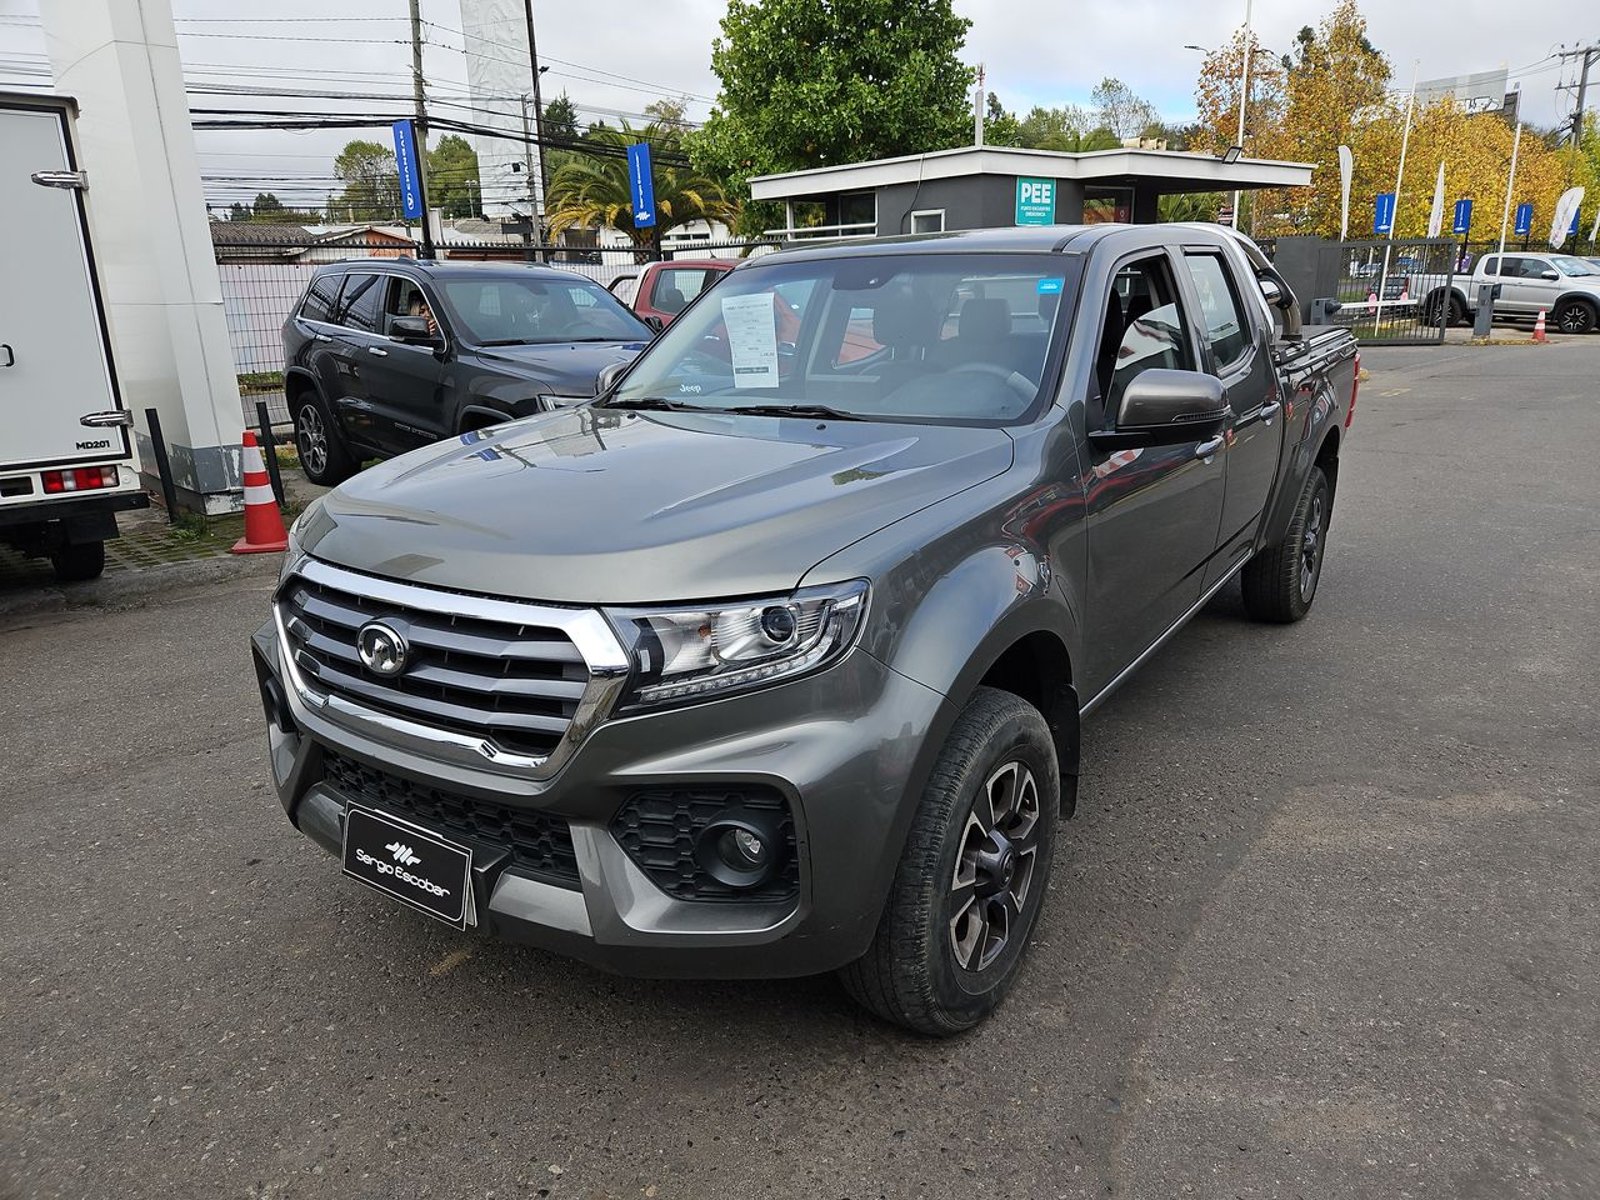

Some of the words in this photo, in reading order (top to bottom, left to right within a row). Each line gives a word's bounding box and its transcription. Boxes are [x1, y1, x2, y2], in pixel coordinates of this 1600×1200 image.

[1021, 182, 1052, 204] PEE
[680, 384, 701, 393] Jeep
[75, 439, 111, 451] MD201
[394, 866, 451, 897] Escobar
